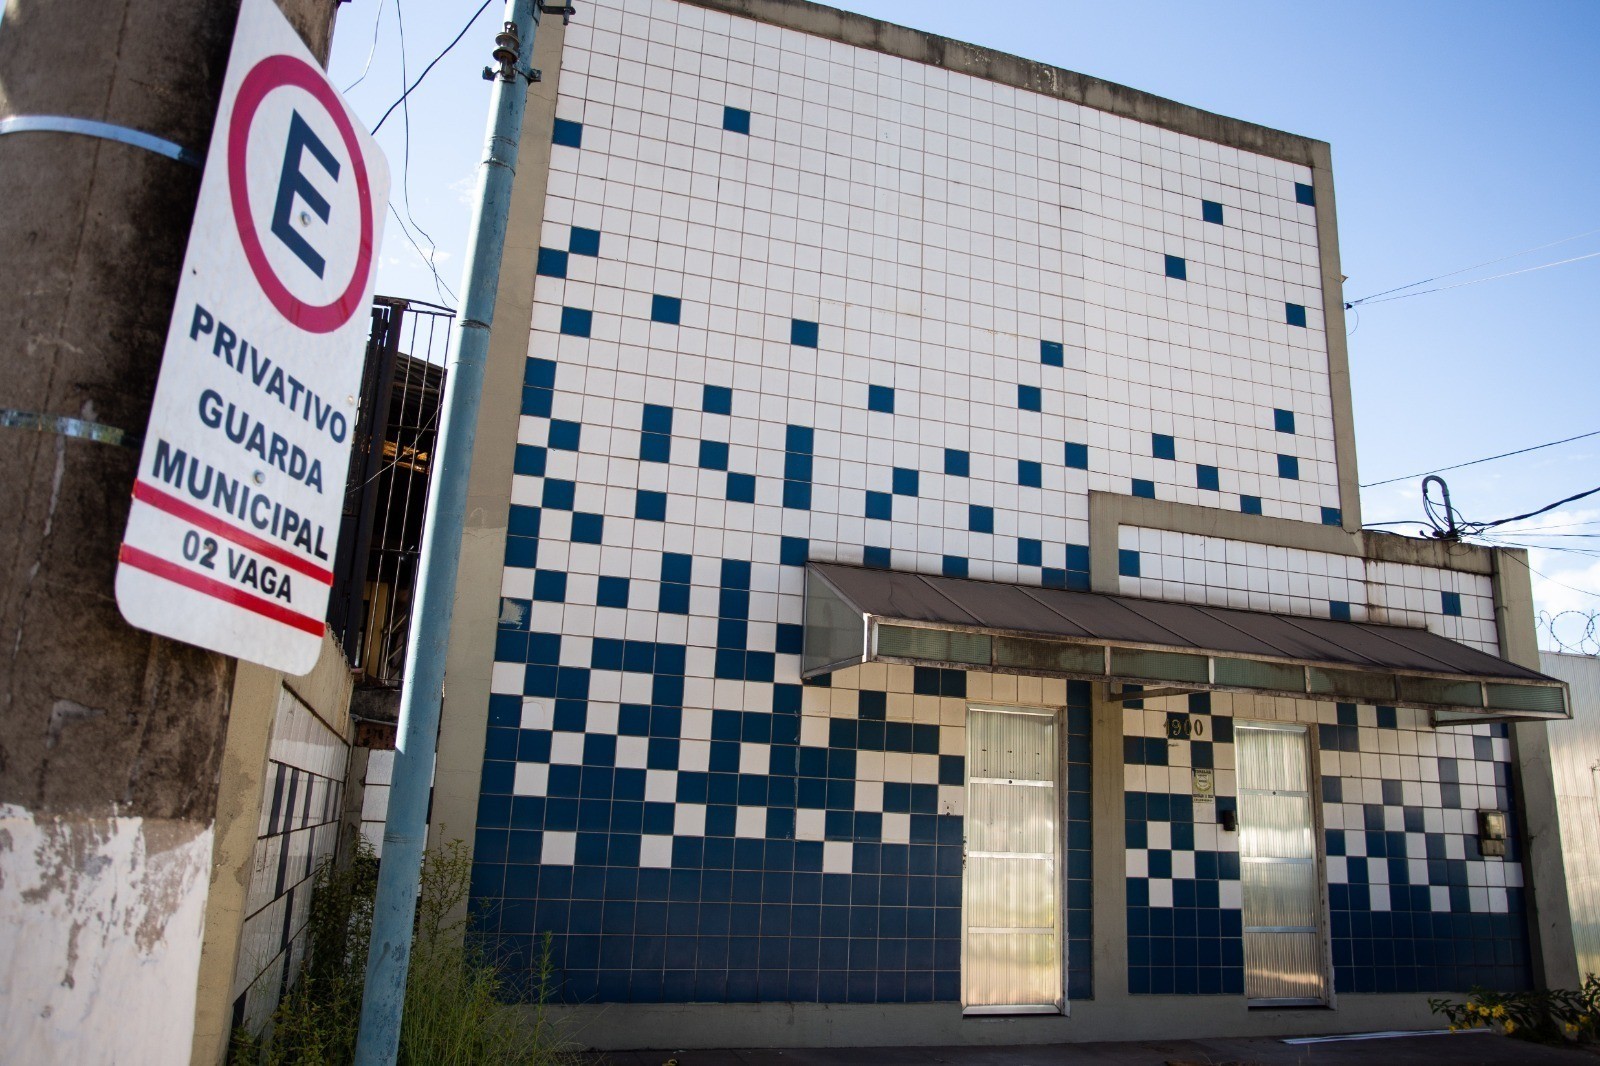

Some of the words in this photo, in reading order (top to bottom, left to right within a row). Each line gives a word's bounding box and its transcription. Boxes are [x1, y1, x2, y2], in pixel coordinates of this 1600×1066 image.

[271, 108, 341, 280] E
[189, 304, 347, 443] PRIVATIVO
[198, 389, 323, 494] GUARDA
[152, 438, 328, 561] MUNICIPAL
[182, 530, 215, 570] 02
[228, 547, 292, 603] VAGA
[1163, 719, 1203, 736] 1900
